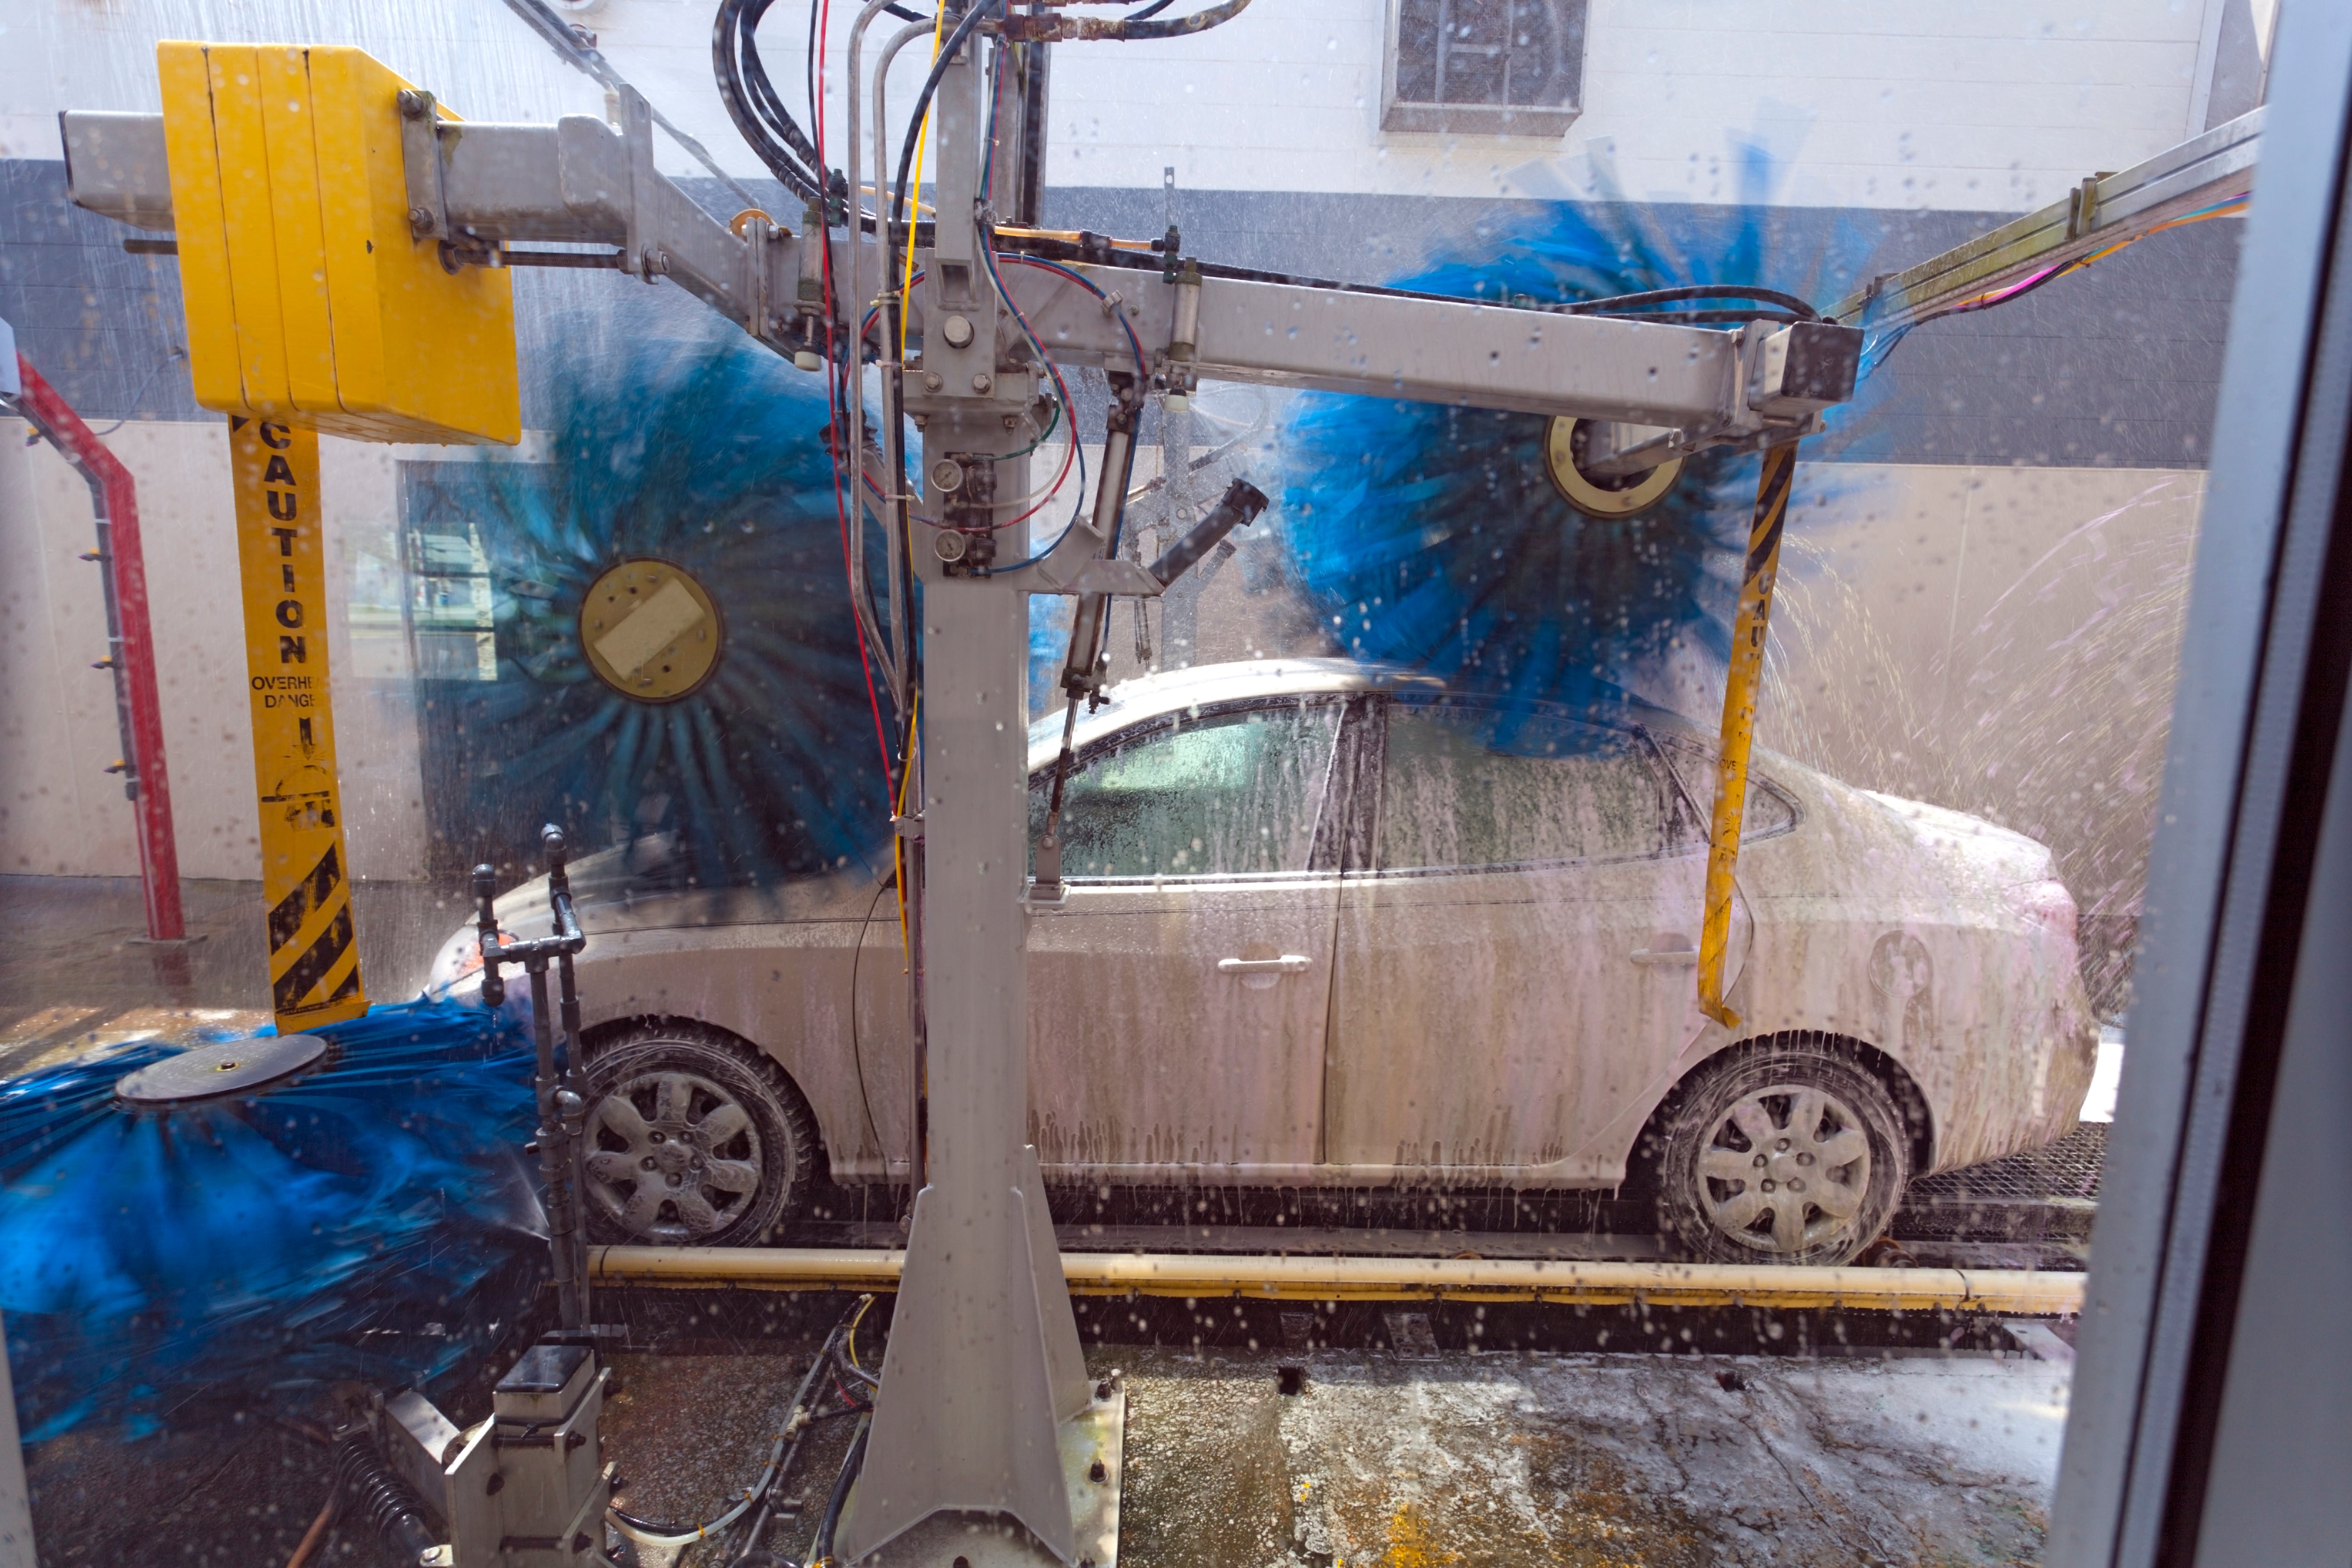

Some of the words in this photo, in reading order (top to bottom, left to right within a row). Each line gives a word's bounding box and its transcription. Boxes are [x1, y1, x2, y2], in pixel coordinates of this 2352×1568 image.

[260, 421, 307, 663] CAUTION
[252, 676, 320, 690] OVERHE
[264, 693, 316, 708] DANGE
